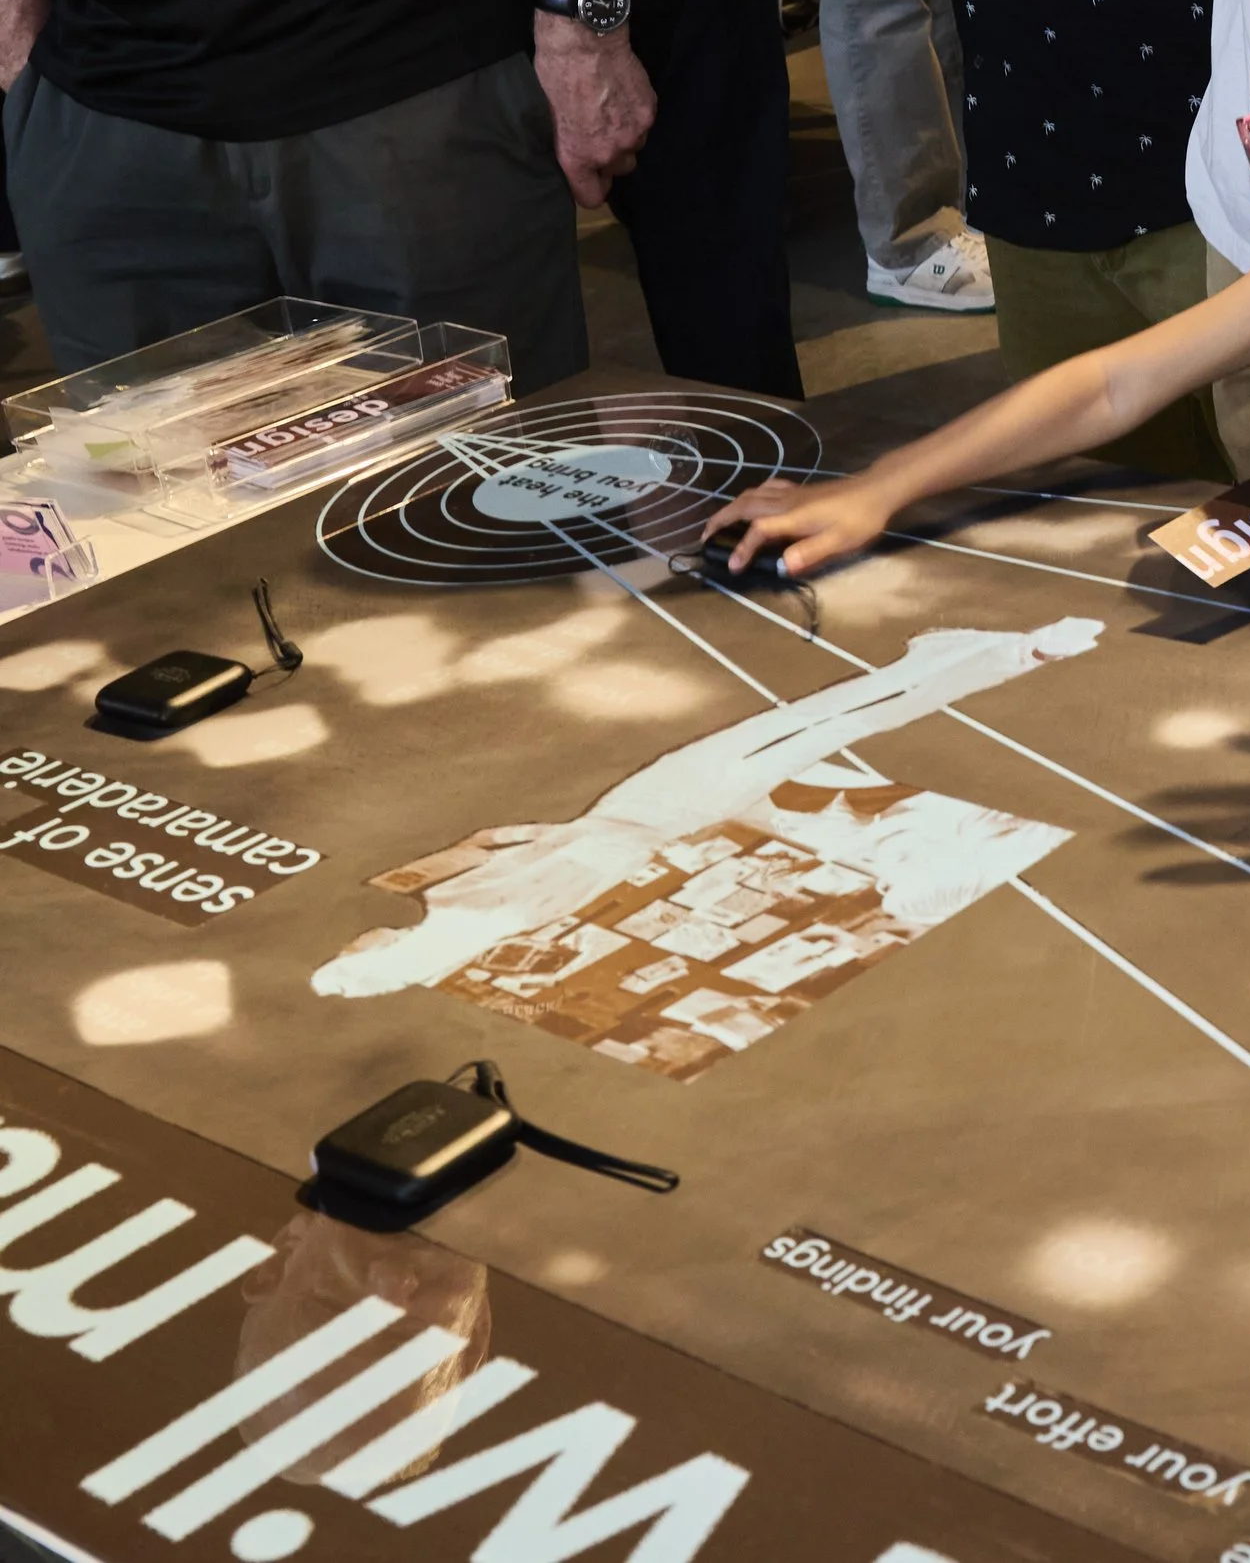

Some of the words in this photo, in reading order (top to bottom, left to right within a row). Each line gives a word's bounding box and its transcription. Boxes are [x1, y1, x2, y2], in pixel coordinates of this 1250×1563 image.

[230, 400, 389, 459] design
[498, 475, 563, 499] heat
[527, 457, 597, 484] bring
[597, 475, 657, 494] you
[563, 490, 610, 510] the
[0, 750, 320, 875] camaraderie
[0, 817, 90, 851] of
[83, 841, 256, 915] sense
[763, 1235, 929, 1323] findings
[929, 1306, 1051, 1360] your
[984, 1382, 1126, 1452] effort
